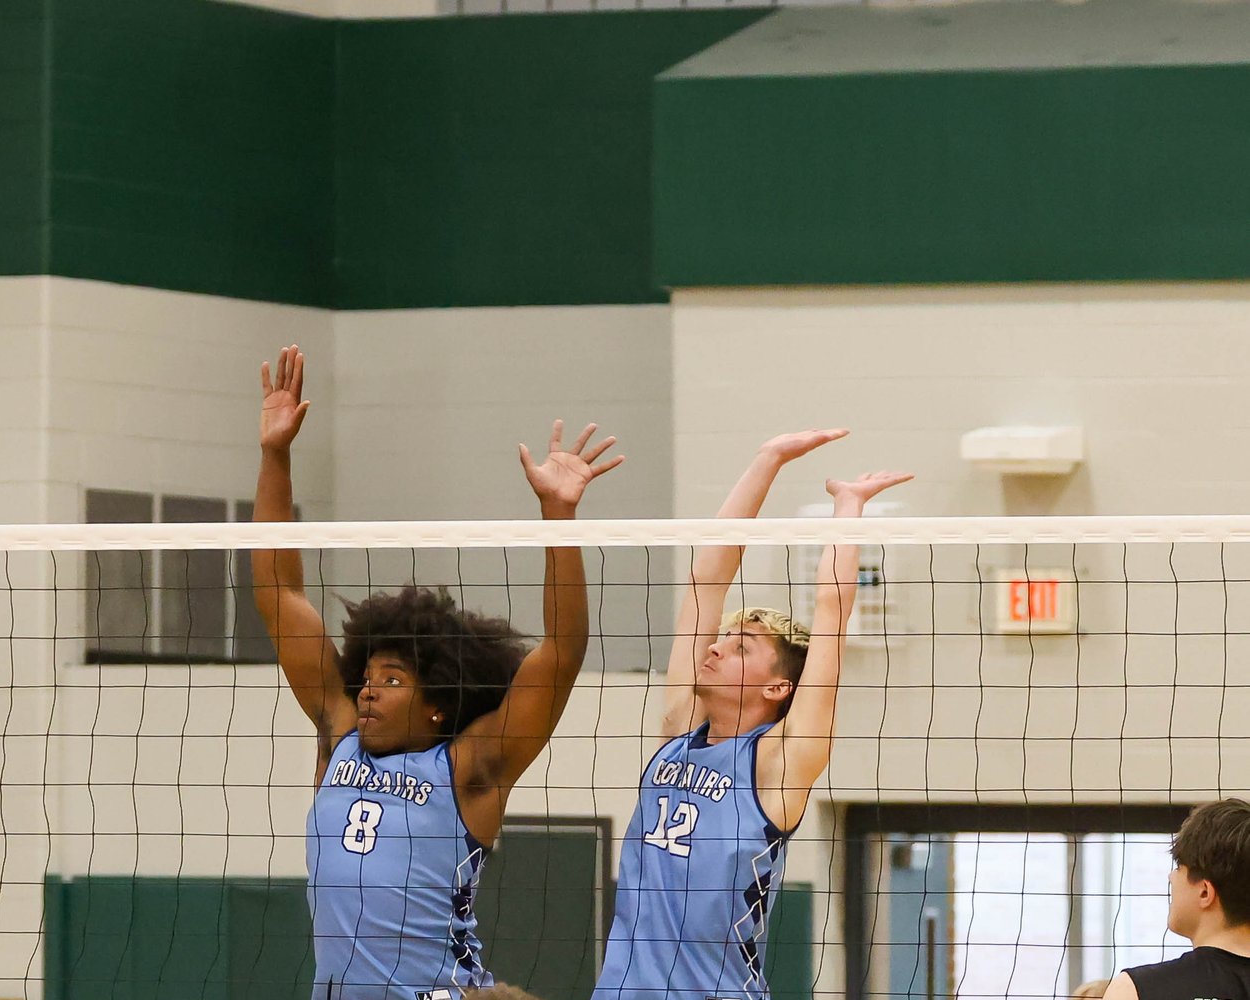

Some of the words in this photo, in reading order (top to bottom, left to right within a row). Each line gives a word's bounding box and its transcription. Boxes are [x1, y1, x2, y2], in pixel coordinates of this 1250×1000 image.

[1009, 579, 1059, 621] EXIT
[330, 759, 433, 806] CORSAIRS
[652, 758, 733, 802] CORAIRS
[342, 798, 384, 855] 8
[644, 795, 700, 858] 12
